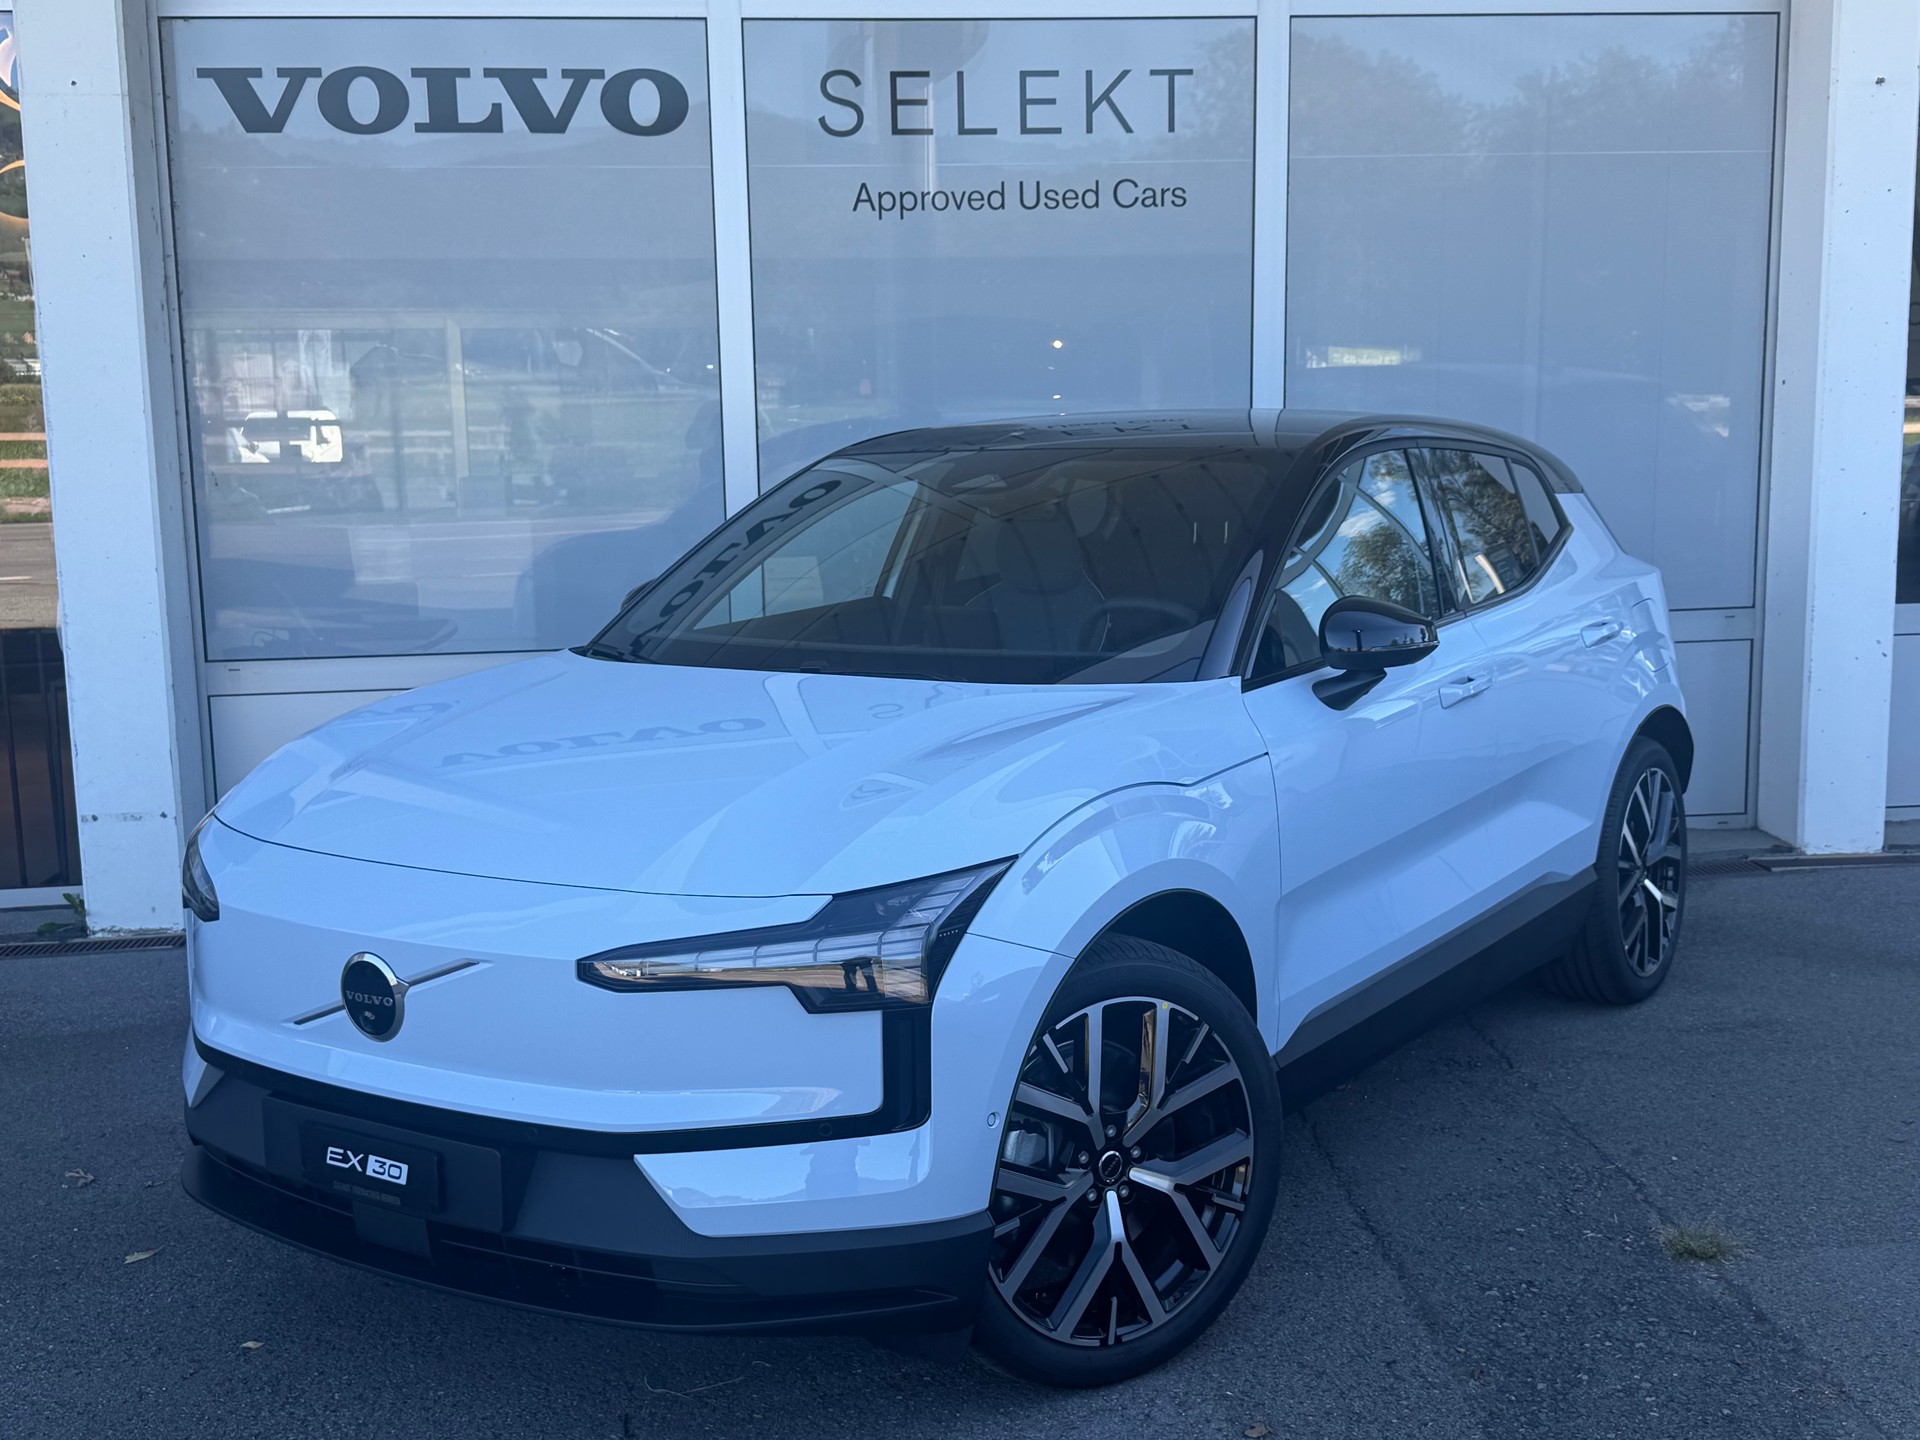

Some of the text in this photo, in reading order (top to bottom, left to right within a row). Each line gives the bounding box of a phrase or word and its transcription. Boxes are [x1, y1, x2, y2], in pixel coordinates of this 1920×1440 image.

[197, 66, 690, 136] VOLVO
[818, 69, 1194, 138] SELEKT
[852, 178, 1188, 220] Approved Used Cars
[346, 990, 393, 1007] VOLVO
